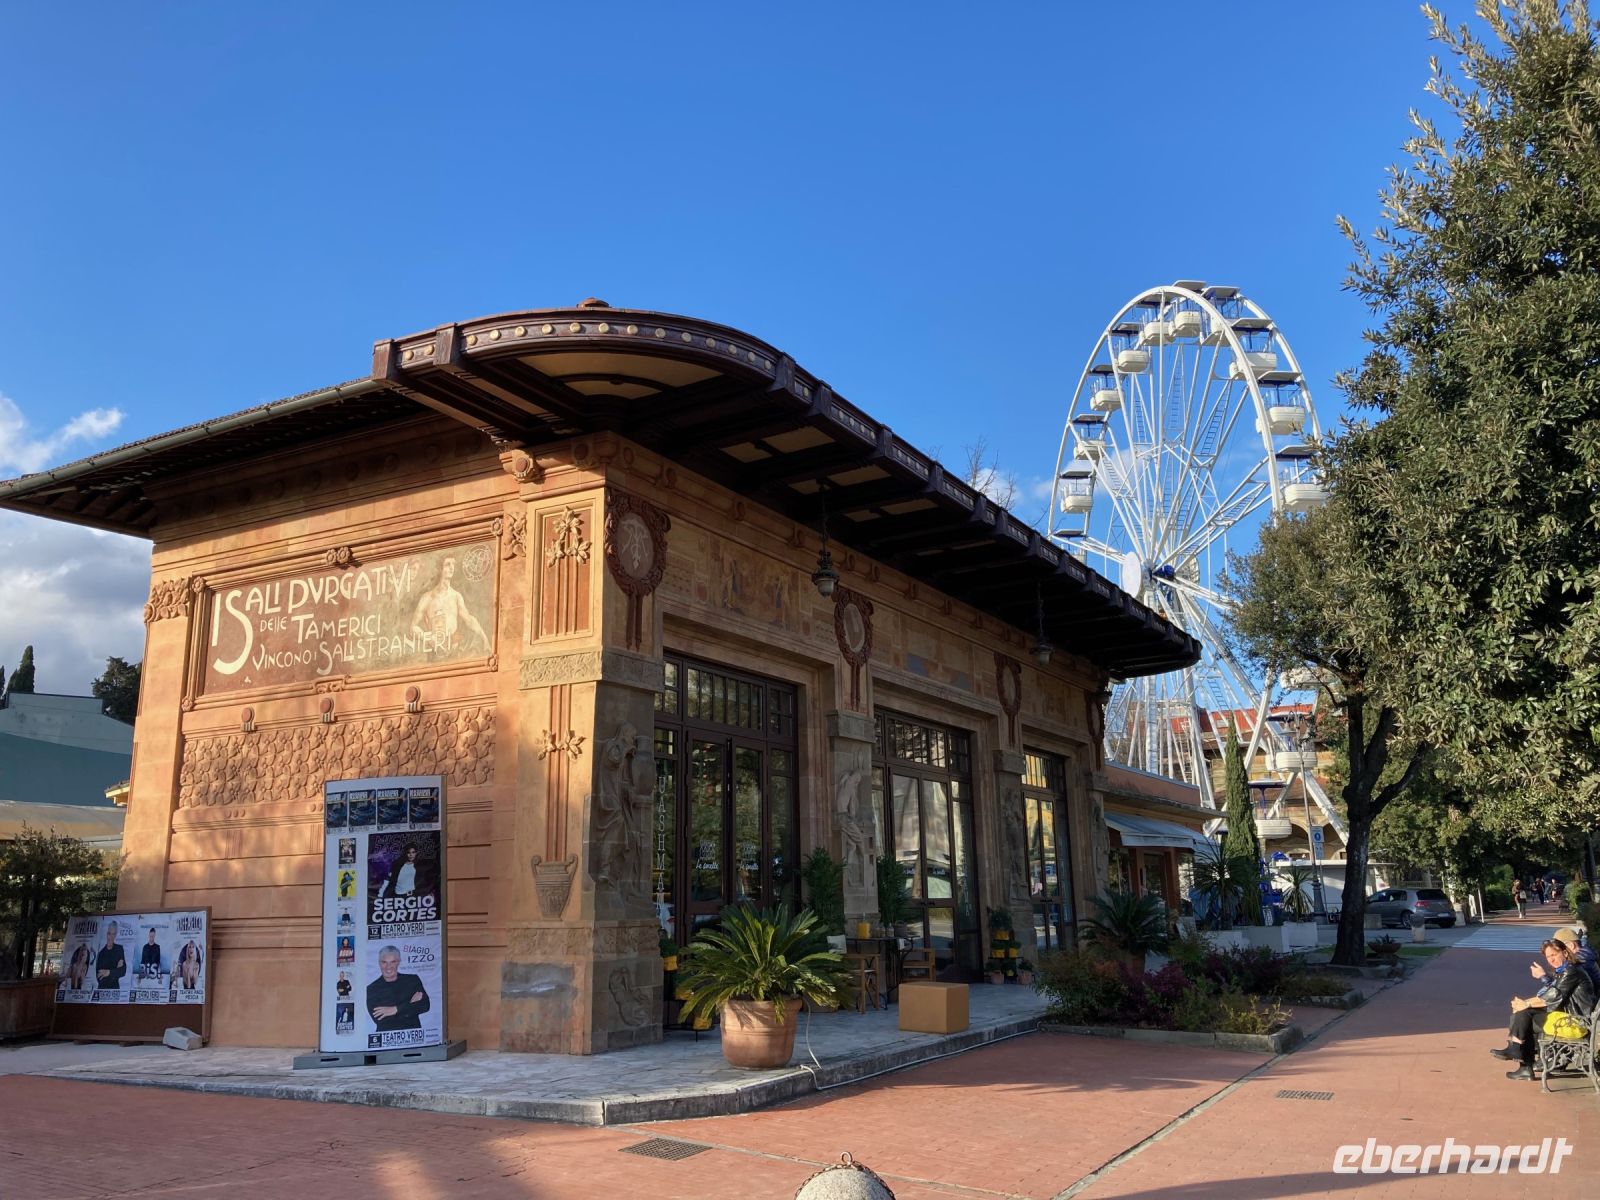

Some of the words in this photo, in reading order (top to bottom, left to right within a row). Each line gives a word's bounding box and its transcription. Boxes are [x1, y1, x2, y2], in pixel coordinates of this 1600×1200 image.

[211, 593, 222, 647] I
[213, 582, 281, 675] SALI
[291, 613, 381, 644] TAMERICI
[252, 643, 312, 671] VINCONO
[316, 640, 355, 676] SALI
[357, 630, 452, 660] STRANIERI
[373, 895, 435, 911] SERGIO
[371, 906, 437, 923] CORTES
[382, 923, 406, 934] TEATRO
[406, 922, 425, 932] VERDI
[403, 944, 430, 955] BIAGIO
[407, 953, 435, 964] IZZO
[383, 1031, 406, 1042] TEATRO
[406, 1029, 425, 1040] VERDI
